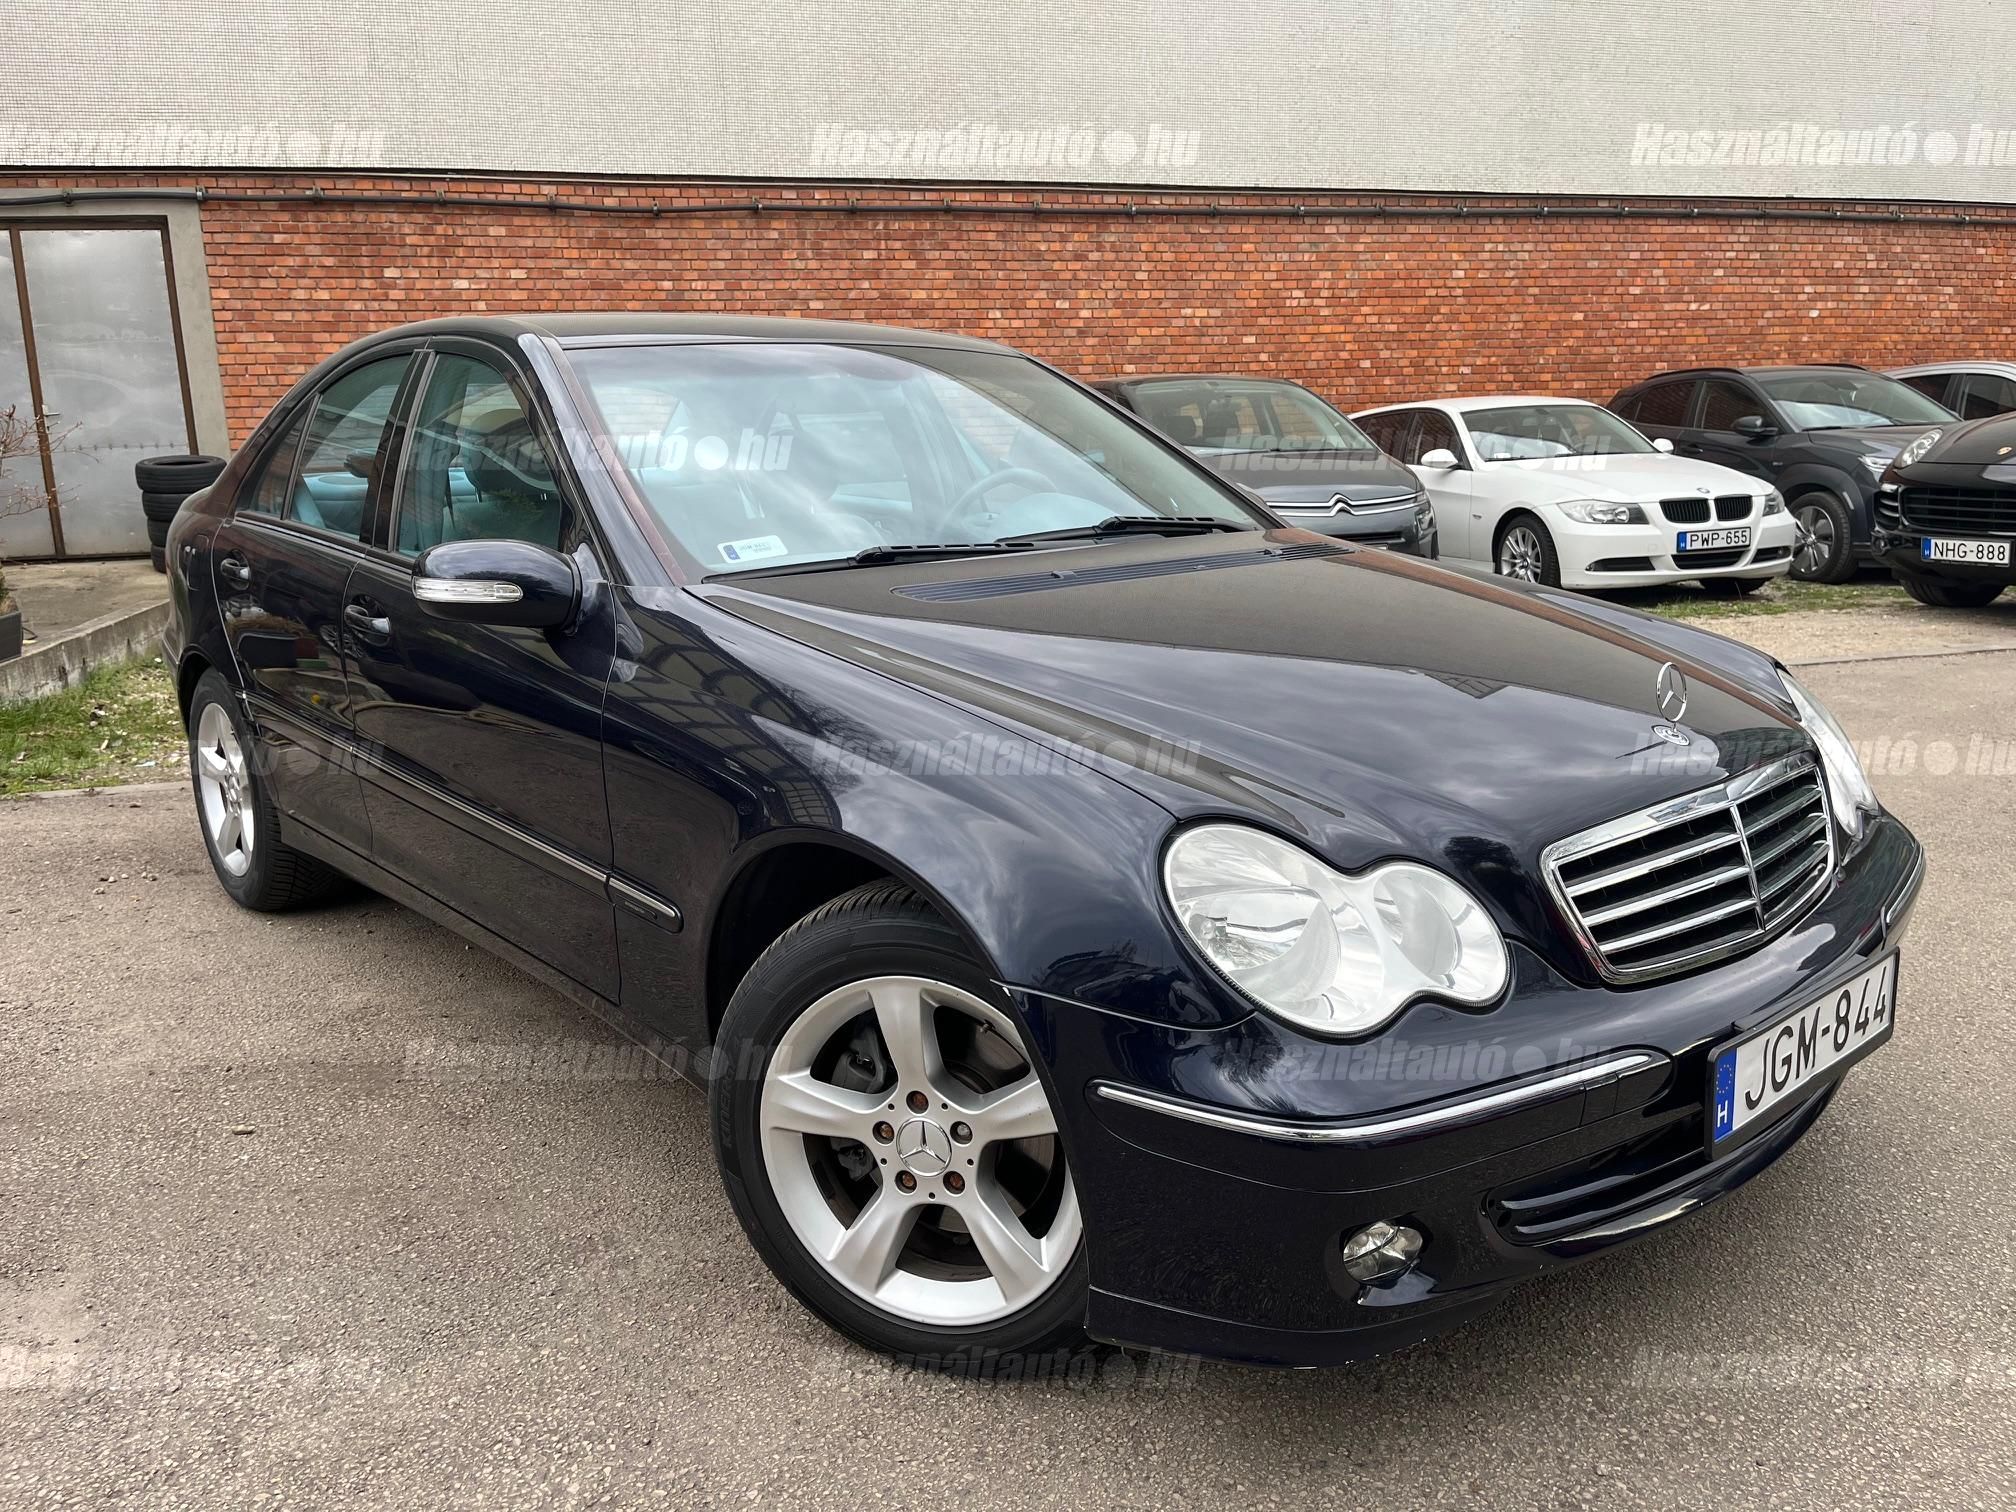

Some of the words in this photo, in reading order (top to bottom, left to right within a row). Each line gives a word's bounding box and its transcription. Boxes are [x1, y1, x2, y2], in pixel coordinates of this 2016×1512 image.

[1689, 529, 1748, 548] PWP-655
[1933, 541, 2006, 561] NHG-888
[1744, 965, 1887, 1111] JGM-844
[1717, 1099, 1729, 1128] H
